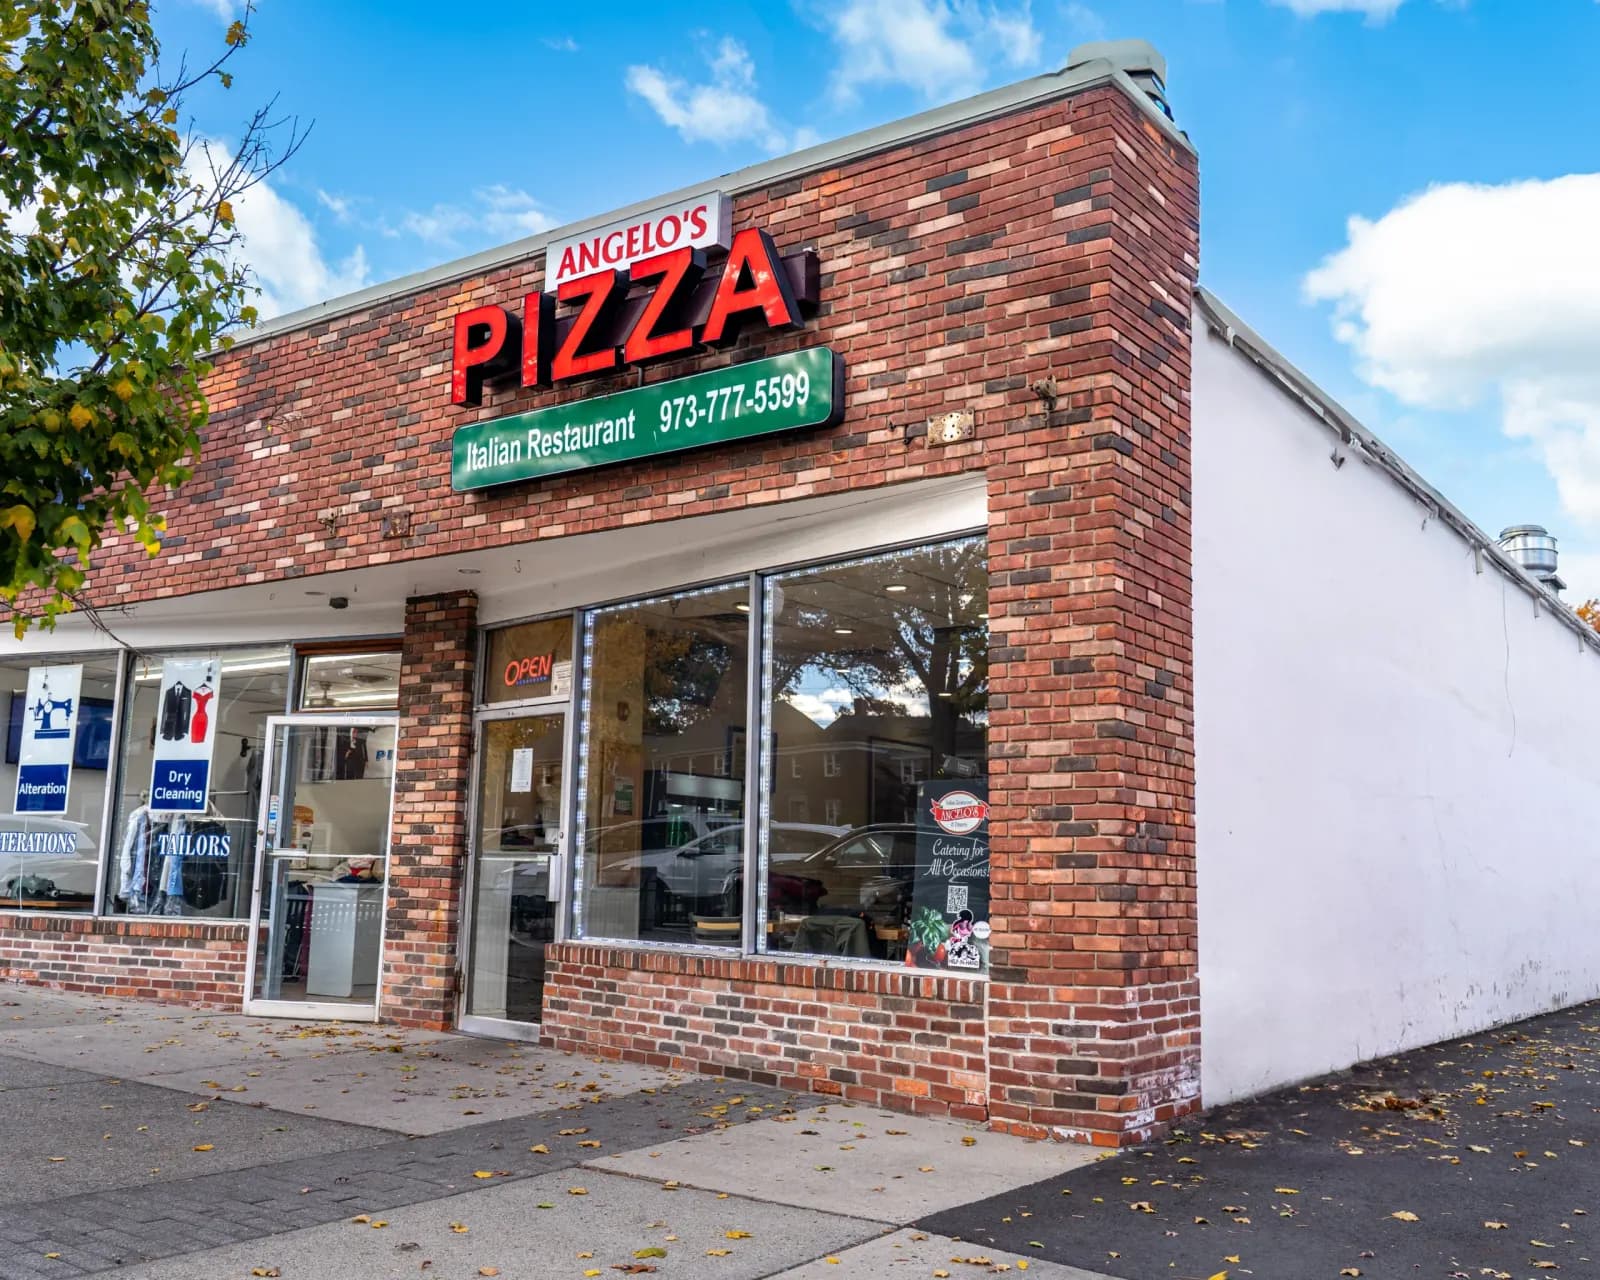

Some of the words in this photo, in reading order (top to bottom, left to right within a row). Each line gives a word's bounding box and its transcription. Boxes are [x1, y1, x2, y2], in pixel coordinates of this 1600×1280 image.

[556, 205, 708, 280] ANGELO'S
[451, 227, 794, 404] PIZZA
[466, 438, 521, 472] Italian
[527, 409, 636, 460] Restaurant
[659, 371, 810, 433] 973-777-5599
[504, 654, 552, 687] OPEN
[18, 782, 66, 795] Alteration
[168, 770, 192, 786] Dry
[154, 787, 203, 802] Cleaning
[158, 834, 231, 857] TAILORS
[932, 838, 970, 860] Catering
[969, 838, 984, 860] for
[923, 857, 942, 876] All
[943, 859, 990, 879] Occasions!
